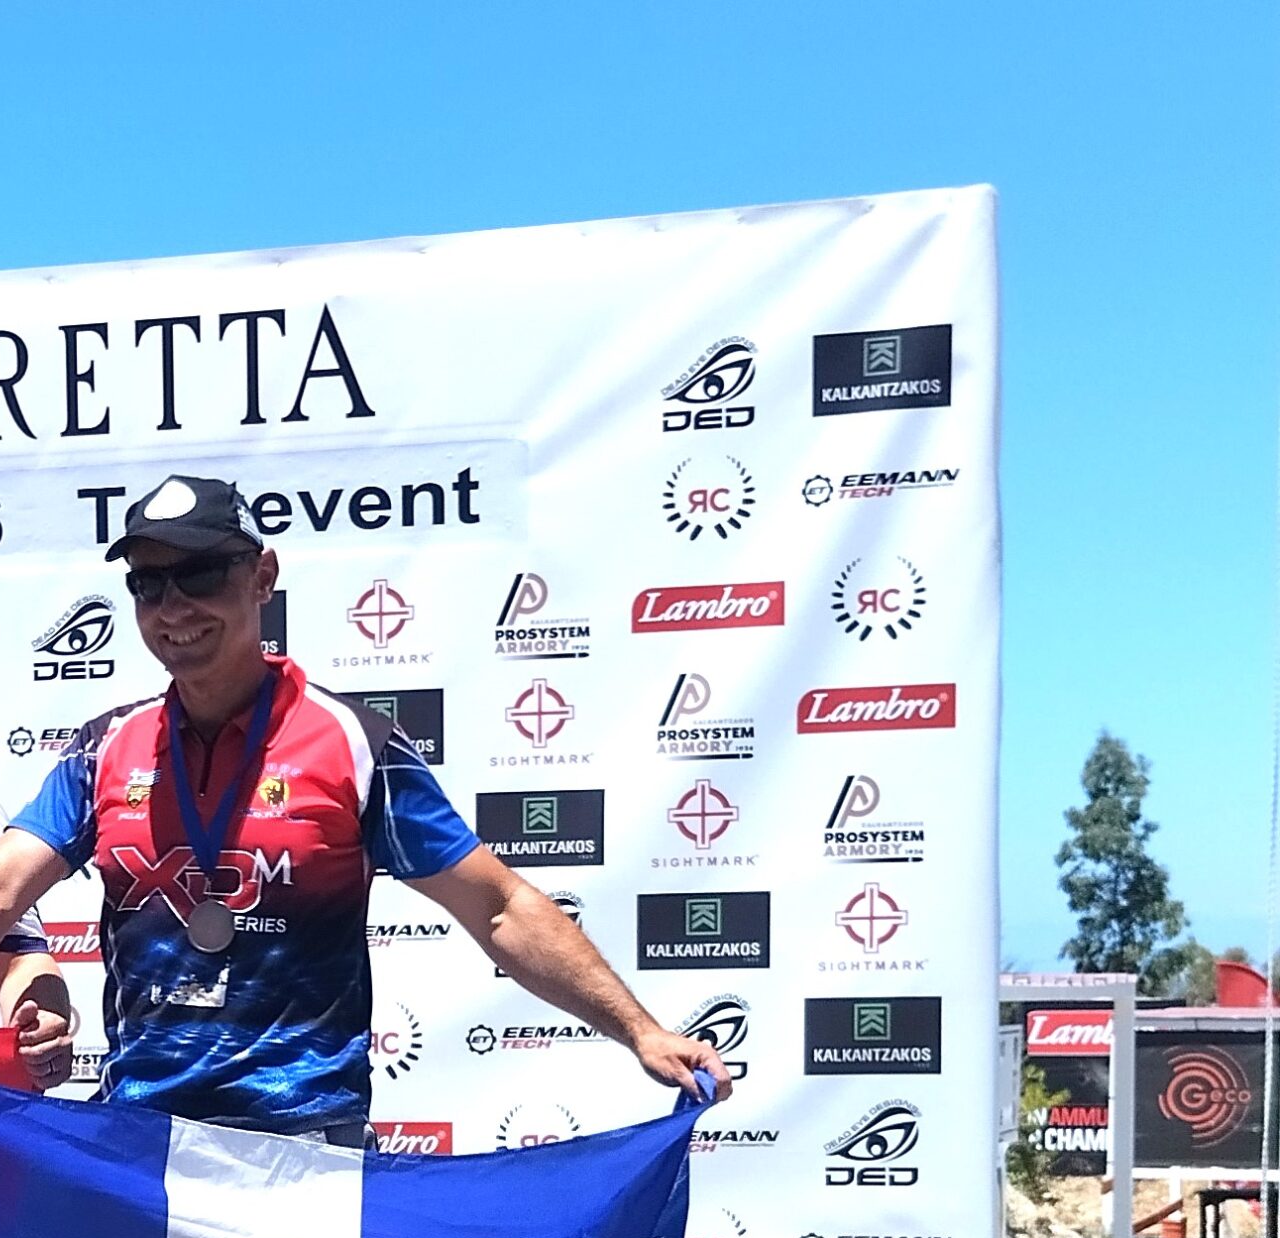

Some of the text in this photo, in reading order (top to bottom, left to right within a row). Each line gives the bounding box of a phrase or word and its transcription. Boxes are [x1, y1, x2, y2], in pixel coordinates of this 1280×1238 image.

[822, 378, 942, 403] KALKANTZAKOS
[662, 405, 756, 432] DED
[840, 468, 961, 487] EEMANN
[838, 486, 894, 499] TECH
[251, 467, 481, 536] event
[637, 586, 771, 623] Lambro
[494, 625, 591, 641] PROSYSTEM
[494, 639, 570, 654] ARMORY
[332, 653, 431, 668] SIGHTMARK
[33, 659, 115, 681] DED
[803, 688, 941, 723] Lambro
[656, 726, 755, 742] PROSYSTEM
[656, 740, 734, 754] ARMORY
[490, 754, 592, 767] SIGHTMARK
[824, 830, 925, 844] PROSYSTEM
[823, 843, 903, 857] ARMORY
[651, 855, 756, 868] SIGHTMARK
[233, 915, 288, 933] ERIES
[366, 924, 451, 937] EMANN
[367, 938, 392, 947] CH
[646, 942, 761, 958] KALKANTZAKOS
[818, 959, 926, 971] SIGHTMARK
[502, 1025, 609, 1039] EEMAN
[1027, 1014, 1114, 1045] Lamb
[500, 1039, 552, 1050] TECH
[813, 1047, 932, 1063] KALKANTZAKOS
[1048, 1107, 1108, 1126] AMMU
[688, 1129, 781, 1142] EMANN
[823, 1130, 852, 1151] DEAD
[1044, 1128, 1109, 1151] CHAM
[689, 1143, 717, 1153] CH
[825, 1166, 919, 1187] DED
